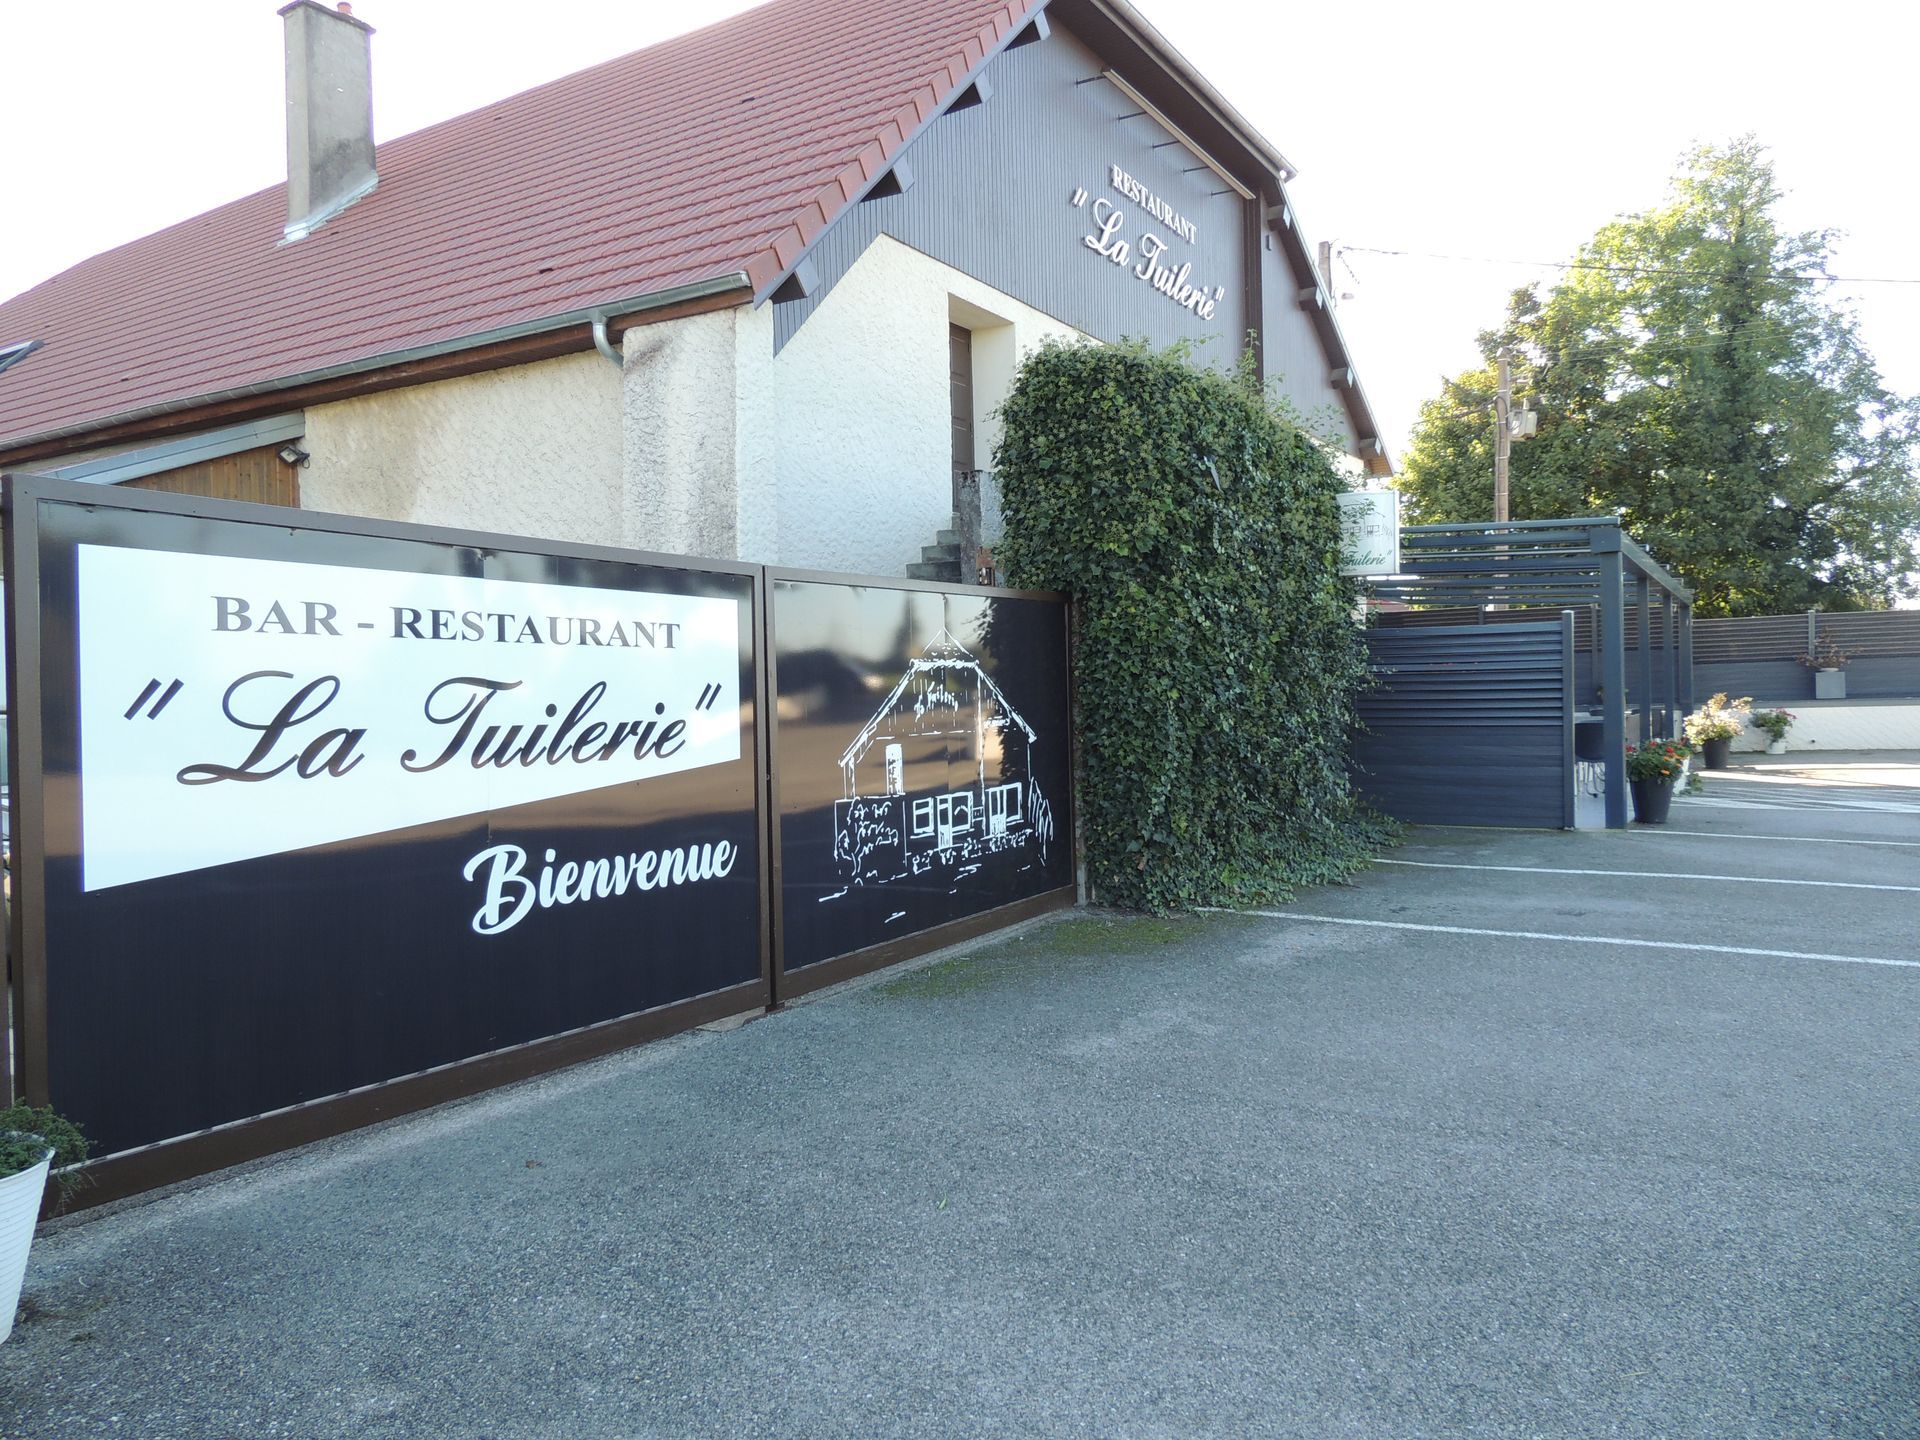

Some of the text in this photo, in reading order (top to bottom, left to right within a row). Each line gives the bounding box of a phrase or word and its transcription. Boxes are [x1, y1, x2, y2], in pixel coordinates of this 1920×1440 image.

[1112, 164, 1197, 245] RESTAURANT
[211, 596, 341, 636] BAR
[389, 607, 681, 649] RESTAURANT
[463, 839, 737, 935] Bienvenue
